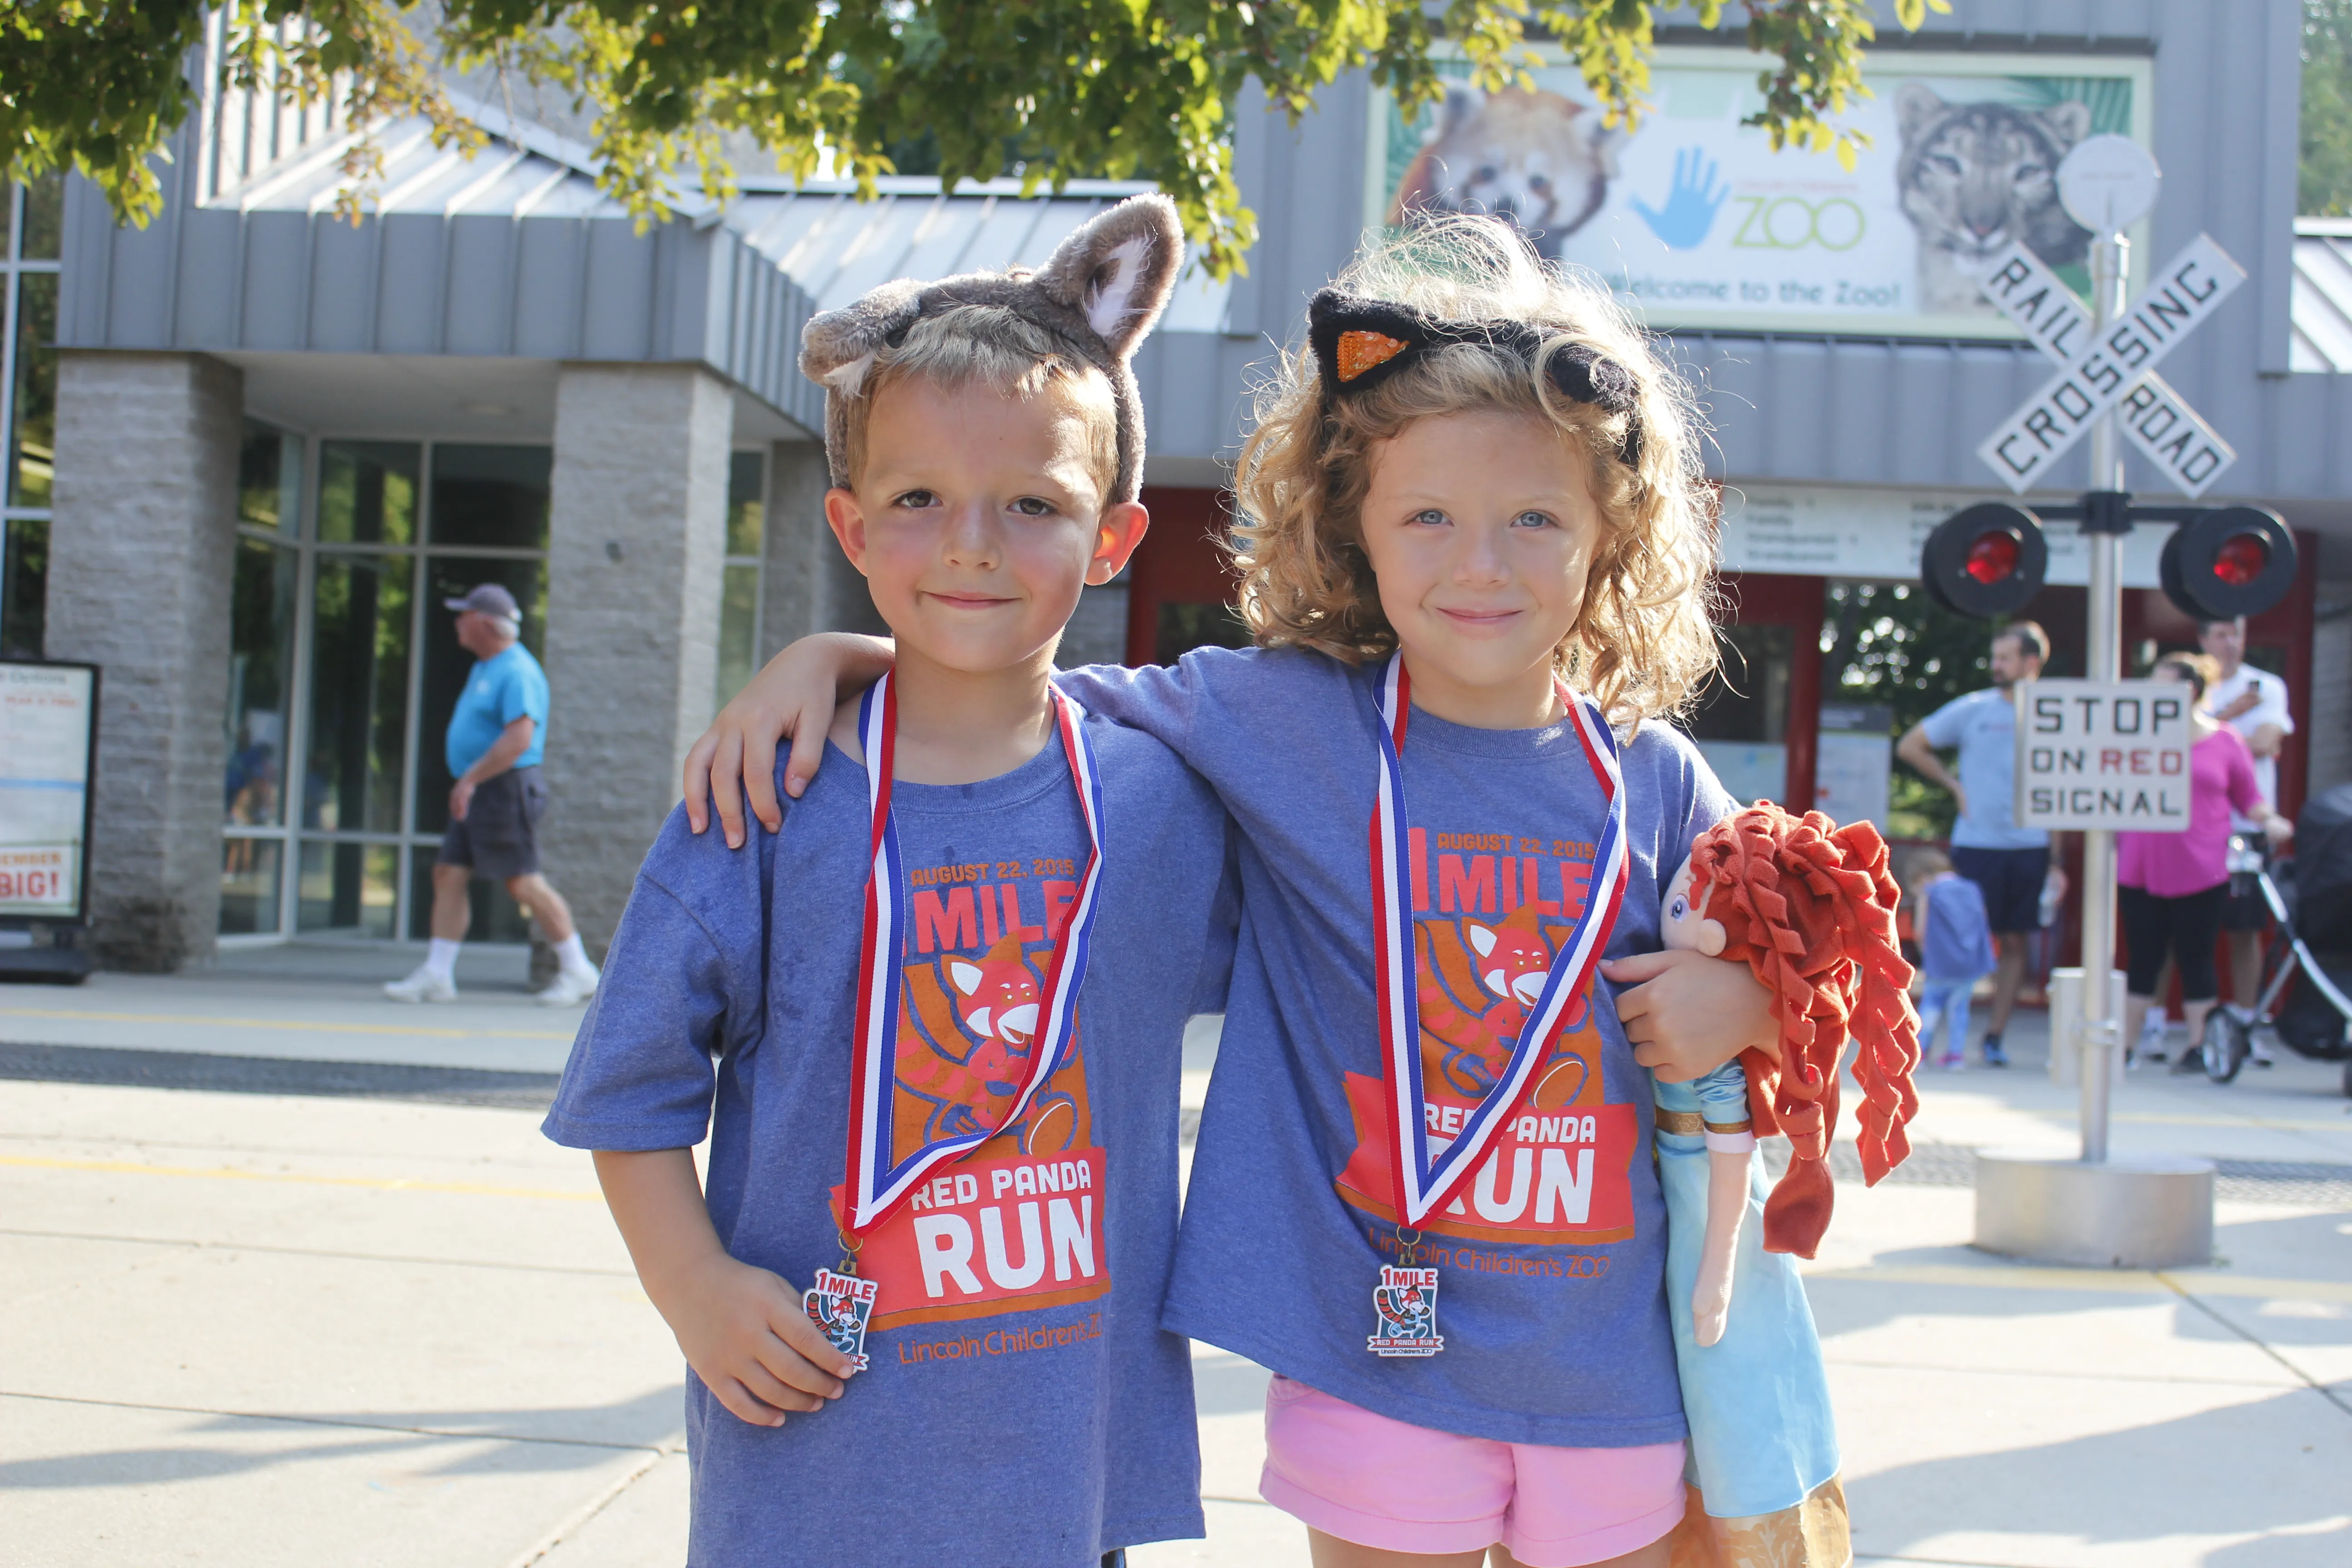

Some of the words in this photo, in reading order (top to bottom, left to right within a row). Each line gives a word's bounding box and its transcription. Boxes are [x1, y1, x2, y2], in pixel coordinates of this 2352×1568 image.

[1735, 196, 1866, 251] ZOO
[1740, 279, 1771, 303] to
[1779, 280, 1823, 304] the
[1835, 281, 1901, 306] Zoo!
[1989, 257, 2081, 359] RAIL
[2122, 384, 2220, 485] ROAD
[1997, 261, 2219, 476] CROSSING
[2035, 697, 2180, 734] STOP
[2031, 750, 2085, 774] ON
[2100, 750, 2182, 775] RED
[2031, 789, 2181, 816] SIGNAL
[1437, 833, 1513, 852] AUGUST
[1519, 838, 1547, 856] 22,
[1553, 840, 1596, 859] 2015
[0, 872, 58, 897] BIG!
[911, 863, 990, 887] AUGUST
[996, 862, 1028, 879] 22,
[1034, 858, 1074, 876] 2015
[1438, 854, 1594, 919] MILE
[1502, 1115, 1596, 1143] ANDA
[911, 1174, 978, 1211] RED
[991, 1160, 1091, 1199] PANDA
[913, 1195, 1095, 1298] RUN
[1455, 1247, 1562, 1278] Children's
[819, 1272, 827, 1291] 1
[828, 1277, 874, 1300] MILE
[1383, 1269, 1391, 1286] 1
[1394, 1272, 1435, 1286] MILE
[898, 1335, 980, 1364] Lincoln
